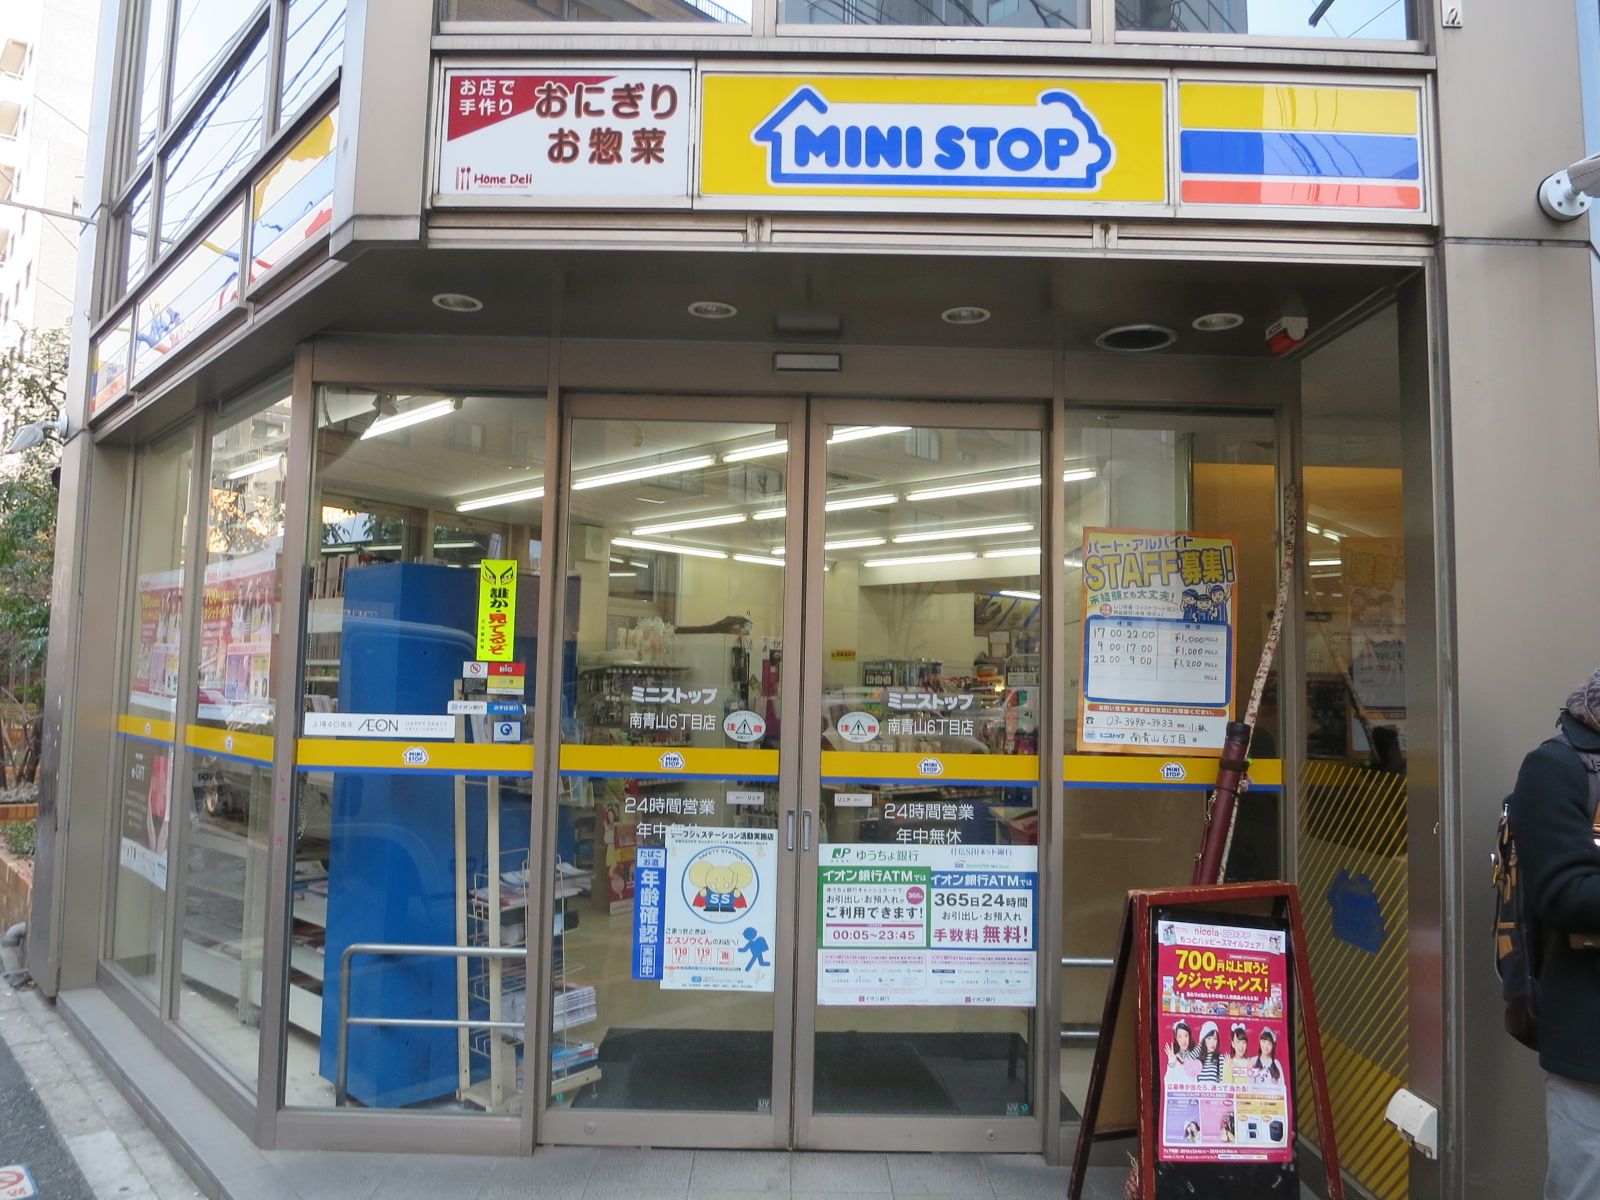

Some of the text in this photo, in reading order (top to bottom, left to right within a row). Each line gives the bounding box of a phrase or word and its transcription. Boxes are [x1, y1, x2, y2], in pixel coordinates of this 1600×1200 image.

[460, 79, 515, 95] お店で
[459, 99, 513, 116] 手作り
[535, 81, 678, 119] おにぎり
[547, 127, 666, 164] お惣菜
[795, 125, 1079, 172] MINI STOP
[510, 174, 532, 185] Deli
[631, 685, 717, 704] ミニストップ
[888, 692, 973, 710] ミニストップ
[630, 712, 716, 731] 南青山6丁目店
[888, 718, 974, 736] 南青山6丁目店
[624, 797, 715, 815] 24時間営業
[884, 803, 975, 821] 24時間営業
[896, 828, 962, 845] 年中無休
[856, 850, 919, 861] ゆうちょ銀行
[823, 870, 926, 881] イオン銀行ATMでは
[931, 874, 1032, 886] イオン銀行ATMでは
[639, 869, 660, 944] 年齢確認
[710, 893, 730, 904] SS
[934, 893, 1028, 908] 365日24時間
[826, 906, 923, 919] ご利用できます!
[942, 911, 1022, 921] お引出し・お預入れ
[1194, 927, 1219, 937] nicola
[1180, 936, 1264, 949] もっとハッピースマイルフェア!
[1176, 949, 1269, 974] 700円以上買うと
[1175, 971, 1269, 993] クジでチャンス!
